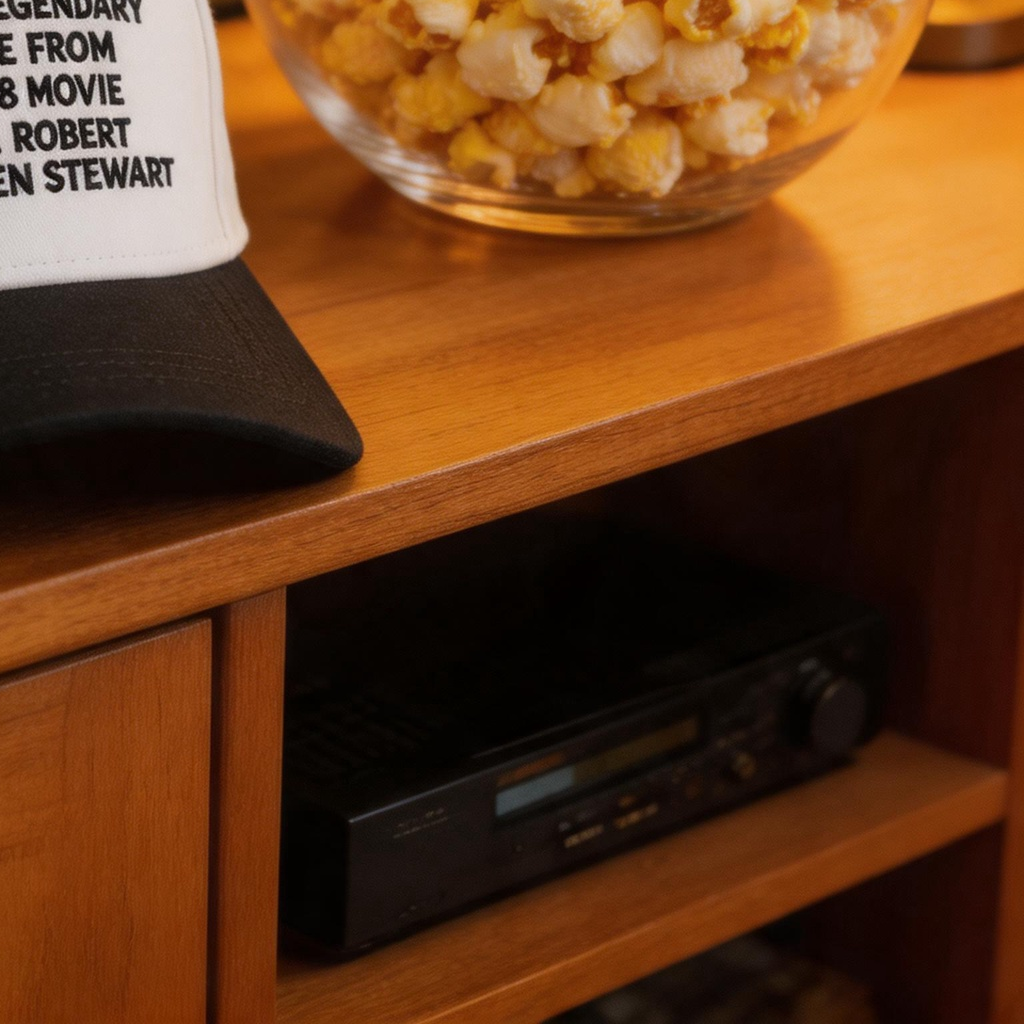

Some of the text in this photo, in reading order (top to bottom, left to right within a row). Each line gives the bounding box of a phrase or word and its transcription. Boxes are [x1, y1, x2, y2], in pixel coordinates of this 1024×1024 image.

[26, 31, 116, 64] FROM
[26, 74, 124, 107] MOVIE
[11, 118, 130, 152] ROBERT
[43, 157, 174, 193] STEWART
